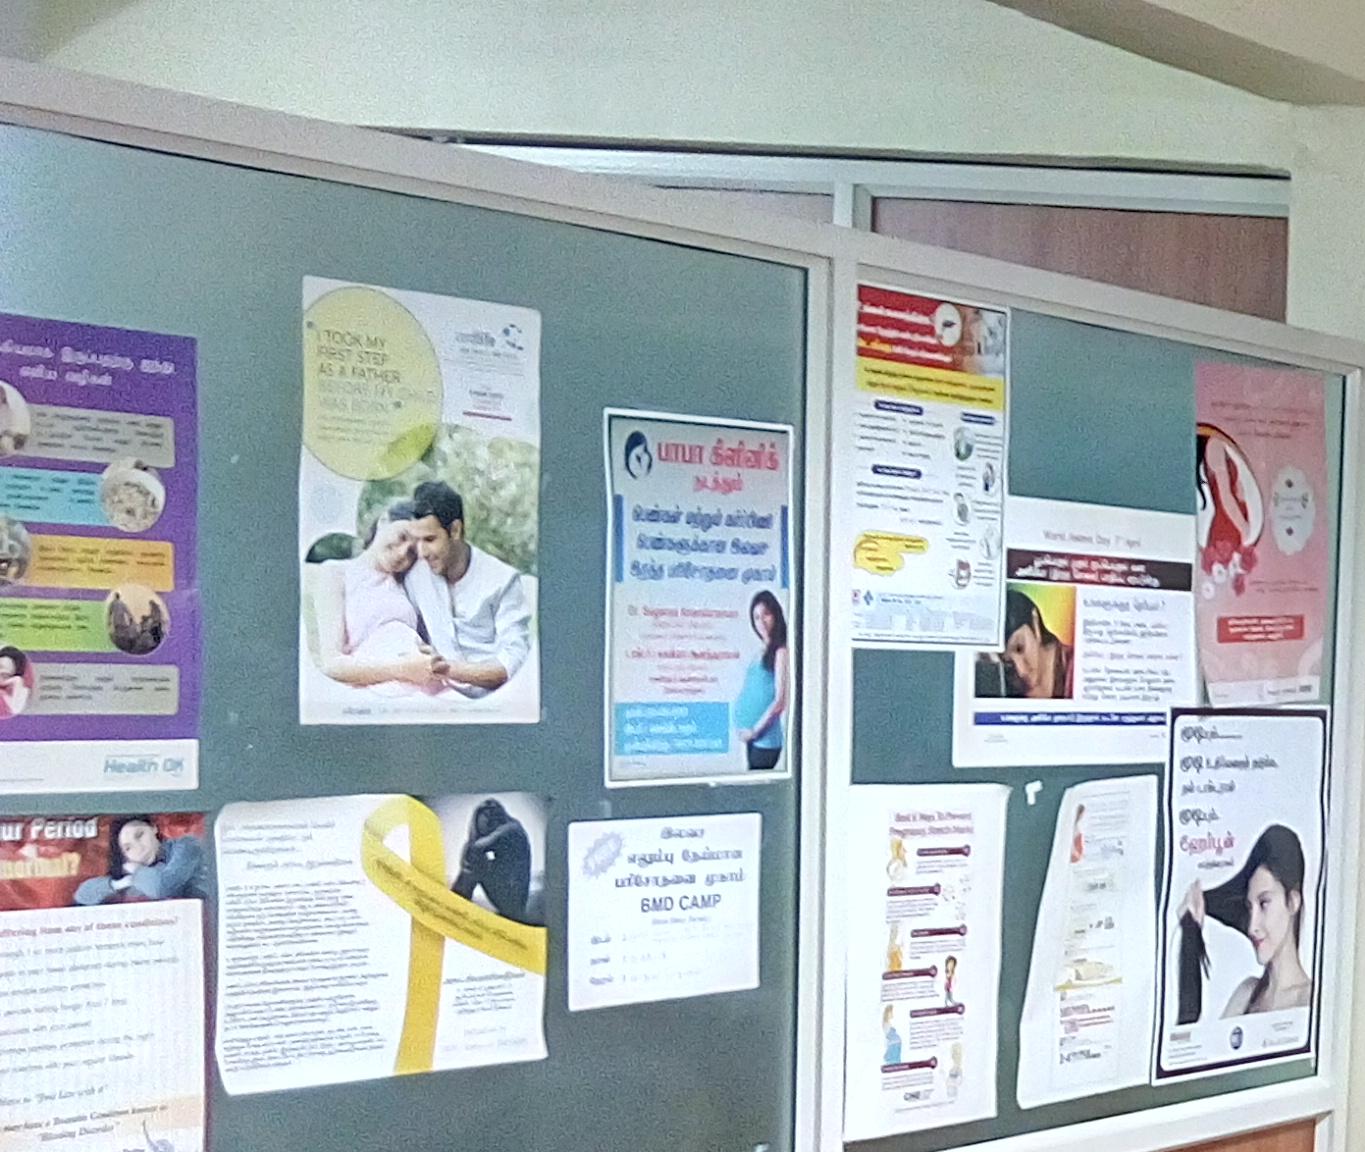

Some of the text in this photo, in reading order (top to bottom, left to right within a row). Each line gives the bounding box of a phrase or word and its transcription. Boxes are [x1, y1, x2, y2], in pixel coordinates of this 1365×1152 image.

[352, 366, 401, 384] FATHER
[657, 442, 704, 464] பாபா
[104, 757, 158, 774] Health
[31, 816, 99, 840] Period
[679, 894, 722, 911] CAMP
